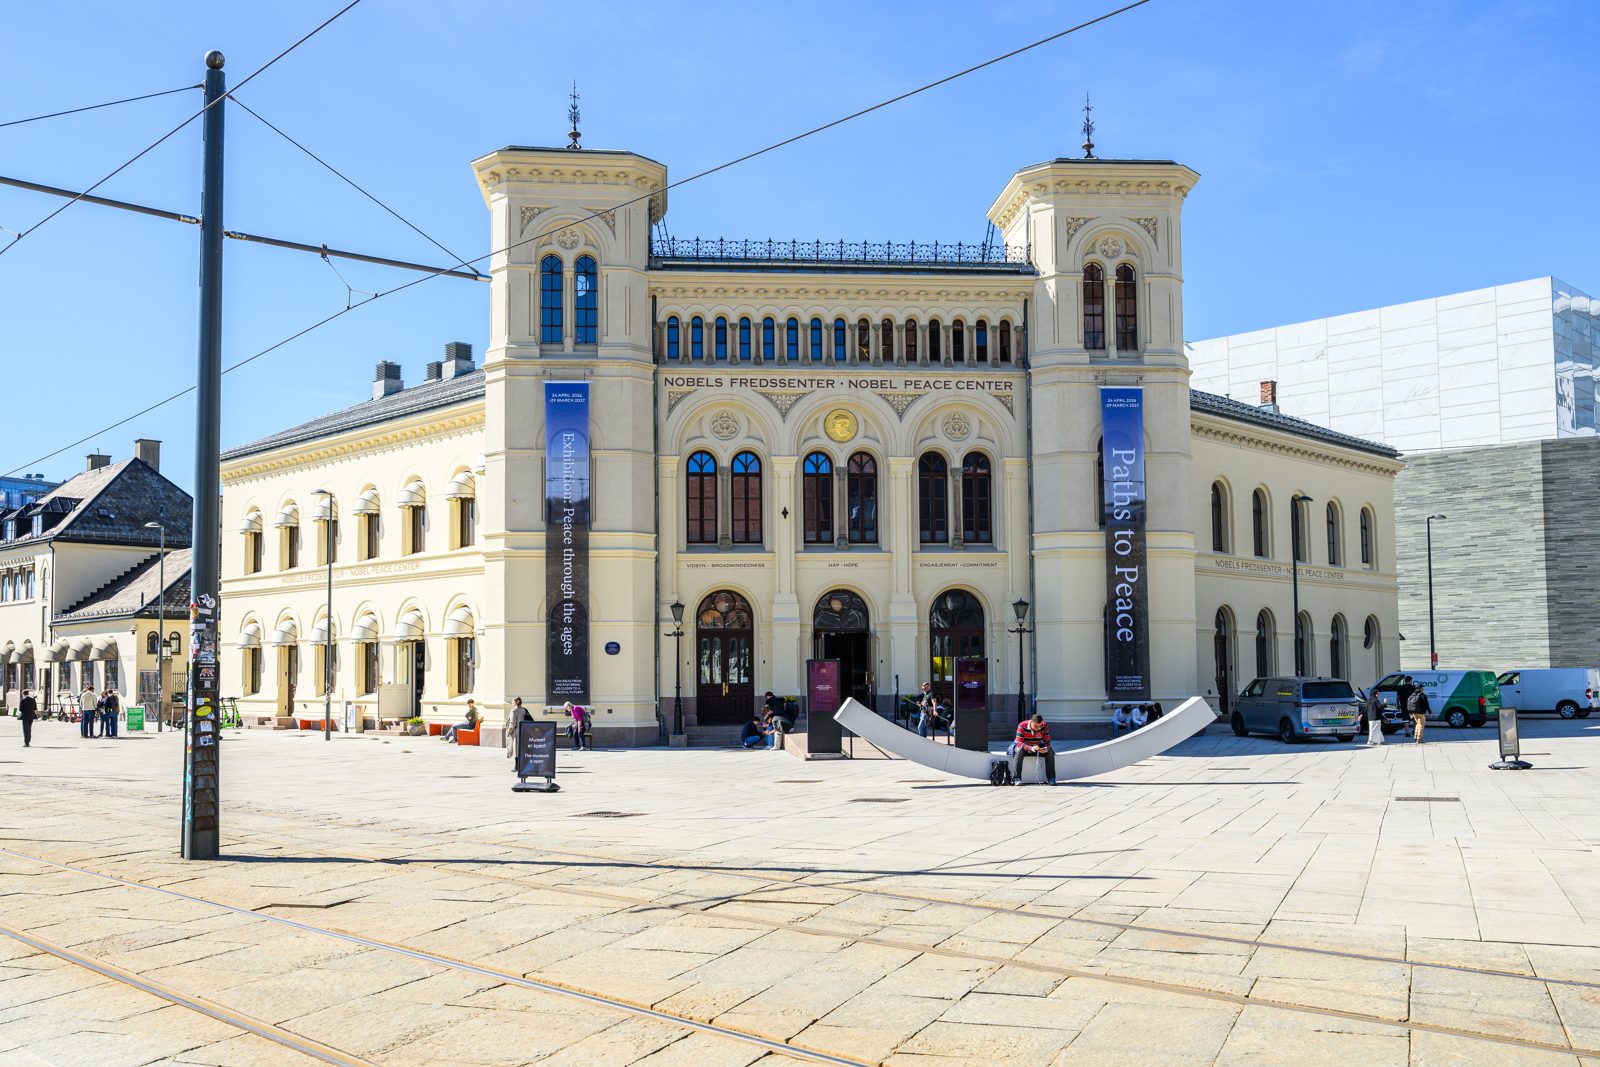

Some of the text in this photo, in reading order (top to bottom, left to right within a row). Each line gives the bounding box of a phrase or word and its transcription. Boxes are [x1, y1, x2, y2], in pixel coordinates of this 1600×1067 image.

[664, 377, 1013, 391] NOBELS FREDSSENTER NOBEL PEACE CENTER
[560, 433, 575, 655] Exhibition: Peace through the ages
[1112, 448, 1138, 642] Paths to Peace
[350, 567, 370, 576] NOBEL
[371, 565, 392, 574] PEACE
[394, 562, 420, 571] CENTER
[1216, 560, 1344, 579] NOBELS FREDSSENTER NOEL PEACE CENTER
